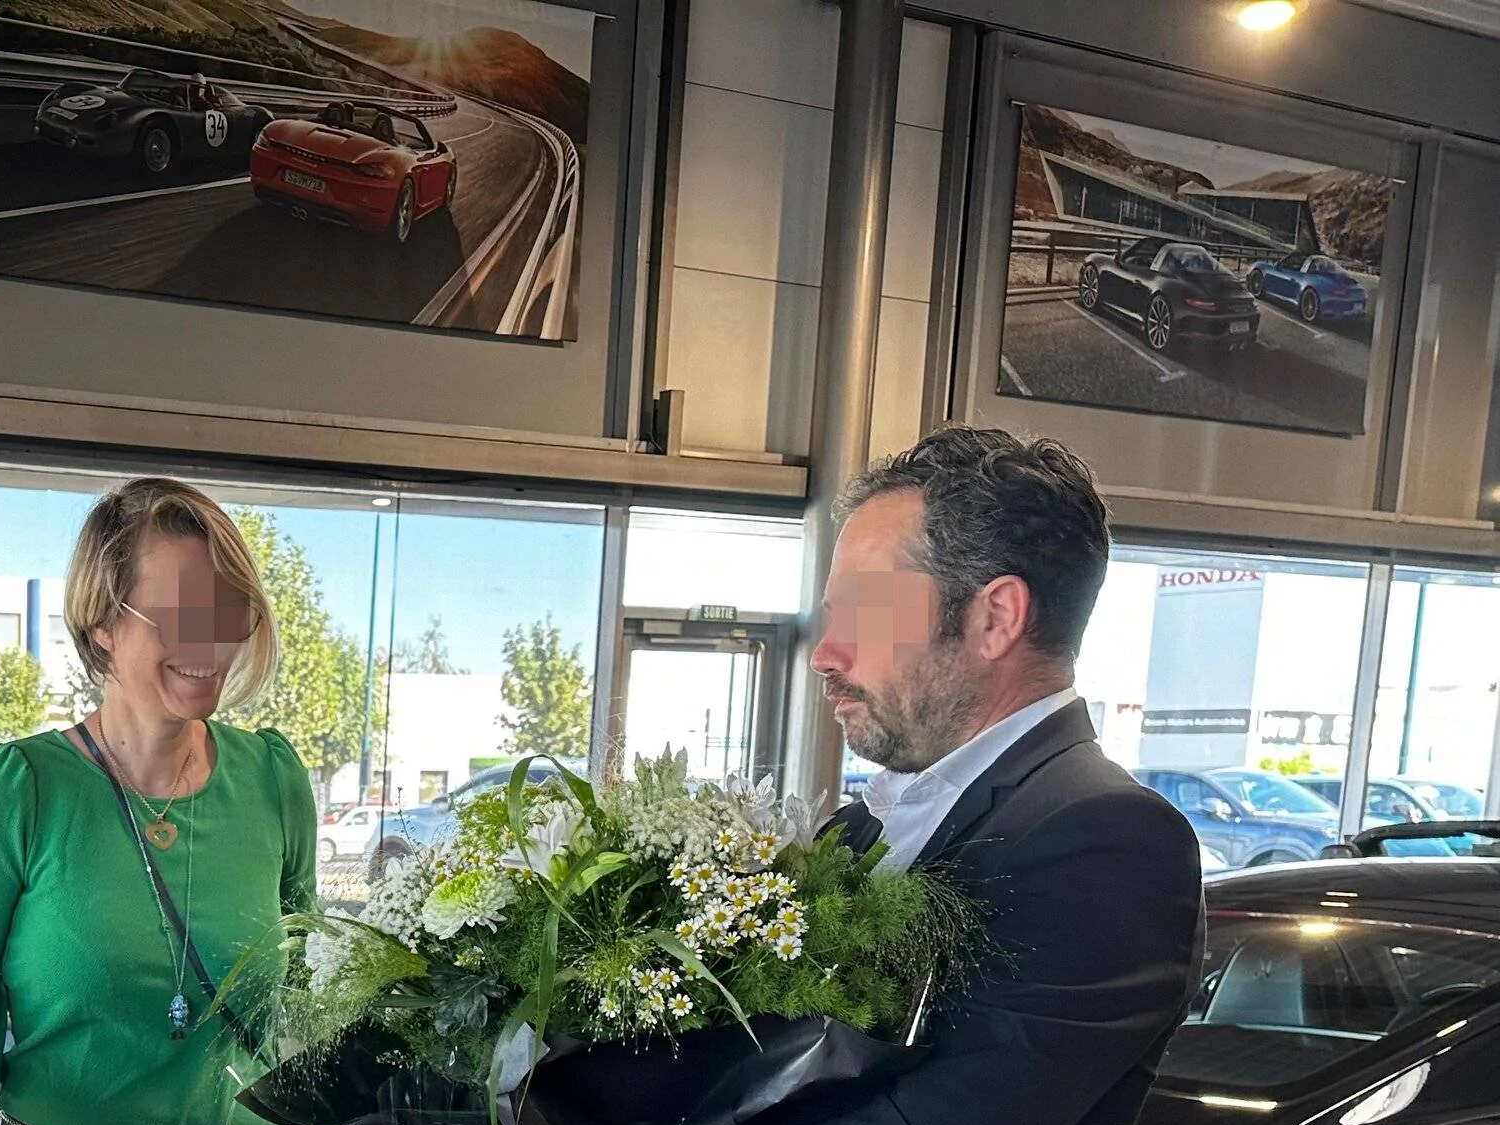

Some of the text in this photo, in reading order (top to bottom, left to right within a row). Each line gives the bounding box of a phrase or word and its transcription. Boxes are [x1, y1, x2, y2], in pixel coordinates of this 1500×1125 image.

[206, 112, 225, 140] 34
[1160, 567, 1262, 587] HONDA
[703, 606, 734, 619] SORTIE
